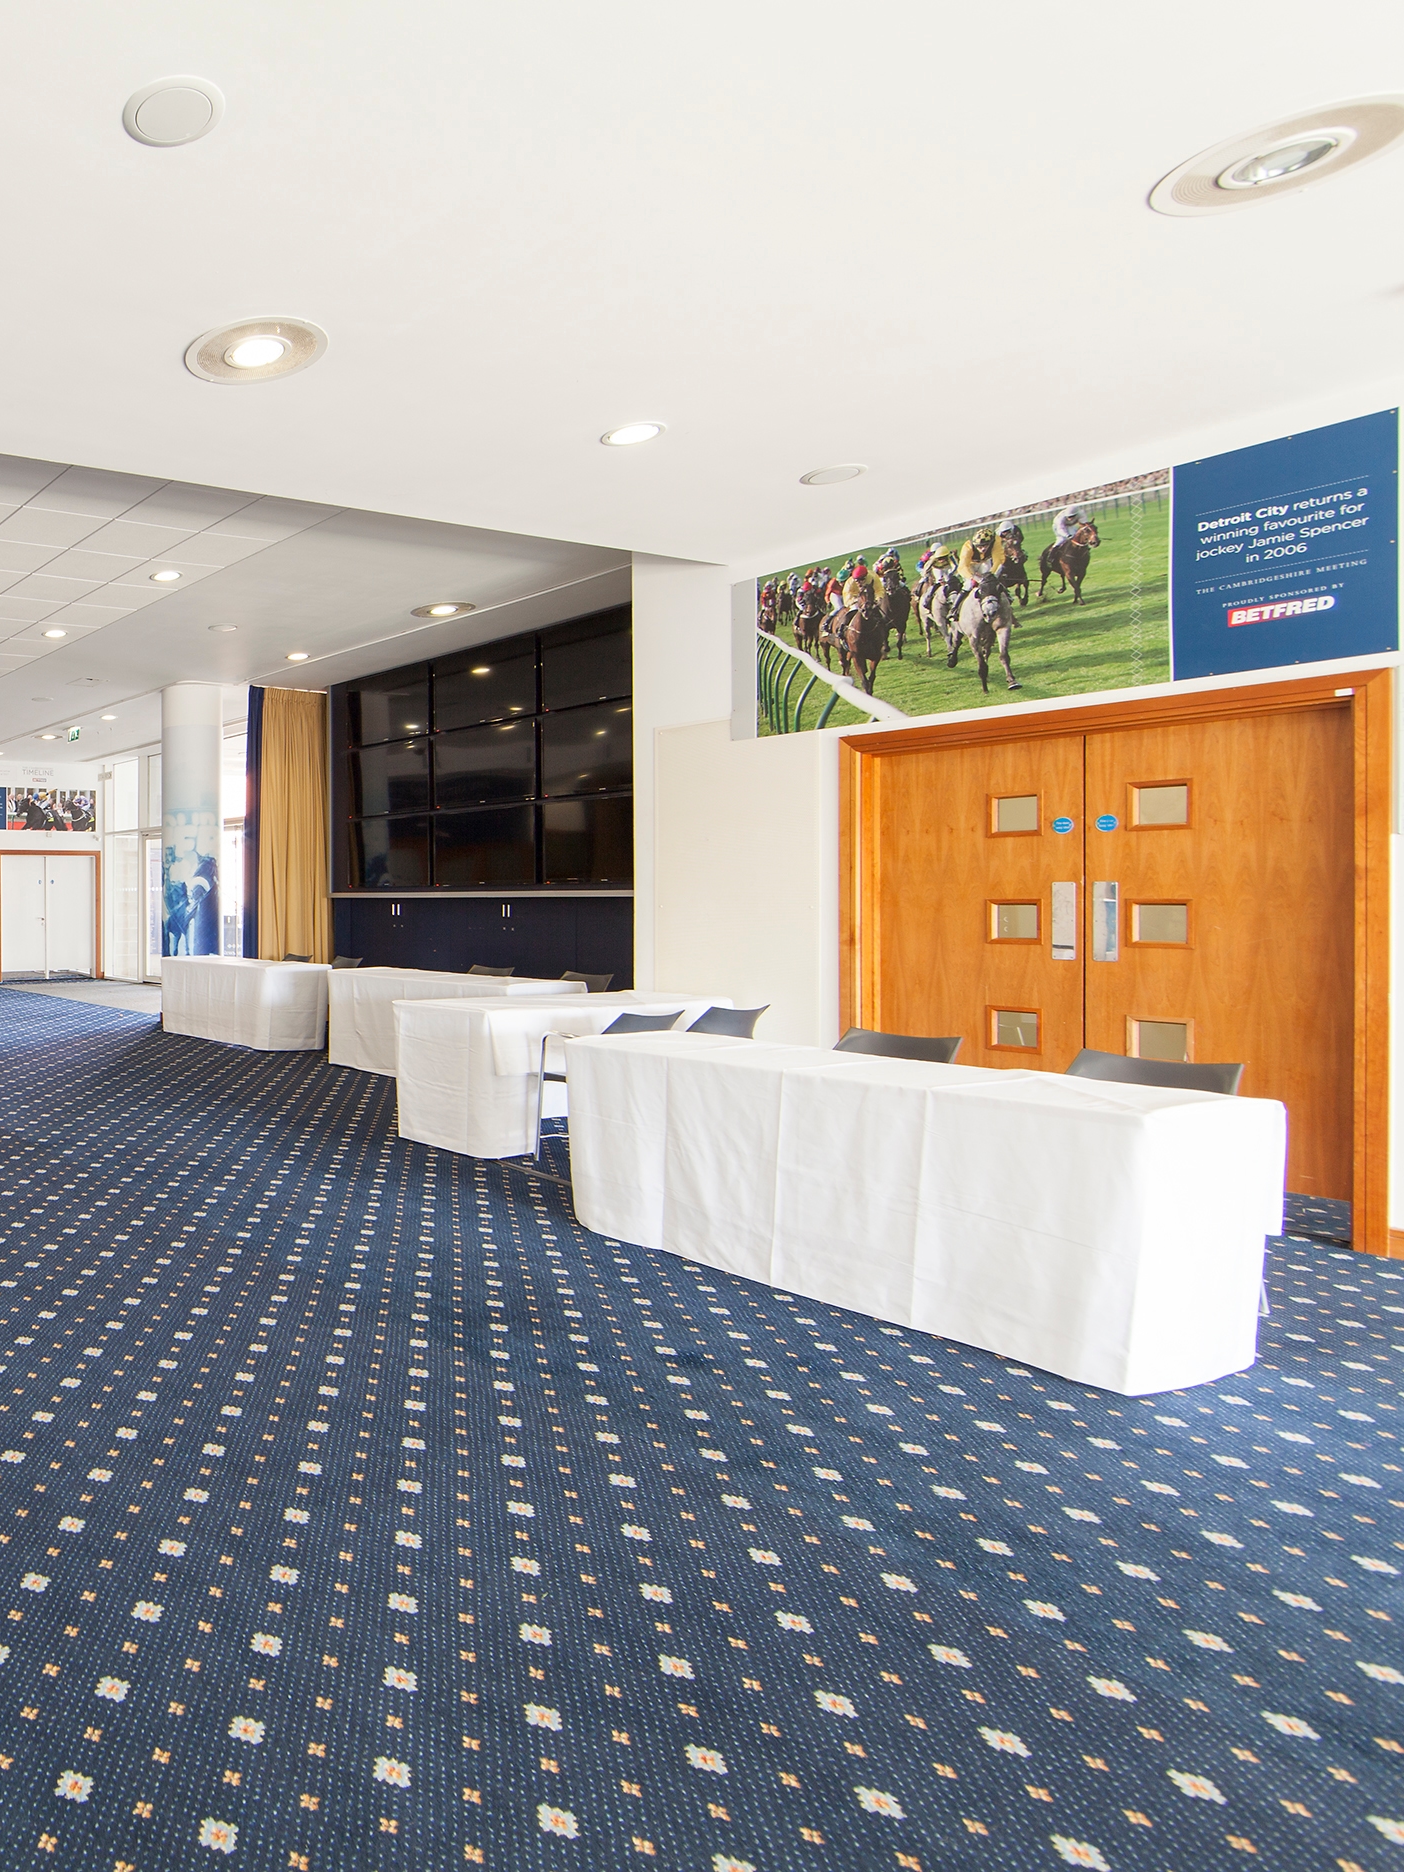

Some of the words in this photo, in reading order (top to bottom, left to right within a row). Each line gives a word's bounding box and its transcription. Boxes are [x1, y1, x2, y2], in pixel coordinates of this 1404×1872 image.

[1197, 511, 1252, 533] Detroit
[1255, 504, 1289, 519] City
[1293, 490, 1353, 511] returns
[1356, 487, 1369, 497] a
[1200, 525, 1260, 545] winning
[1263, 509, 1336, 532] favourite
[1340, 502, 1366, 515] for
[1195, 542, 1245, 562] jockey
[1248, 532, 1296, 549] Jamie
[1299, 516, 1370, 538] Spencer
[1246, 553, 1260, 563] in
[1263, 542, 1308, 561] 2006
[1196, 586, 1215, 595] THE
[1219, 570, 1312, 591] CAMBRIDGESHIRE
[1316, 558, 1368, 573] MEETING
[1222, 596, 1265, 608] PROUDLY
[1269, 585, 1328, 600] SPONSORED
[1332, 582, 1345, 590] BY
[1231, 595, 1335, 625] BETFRED
